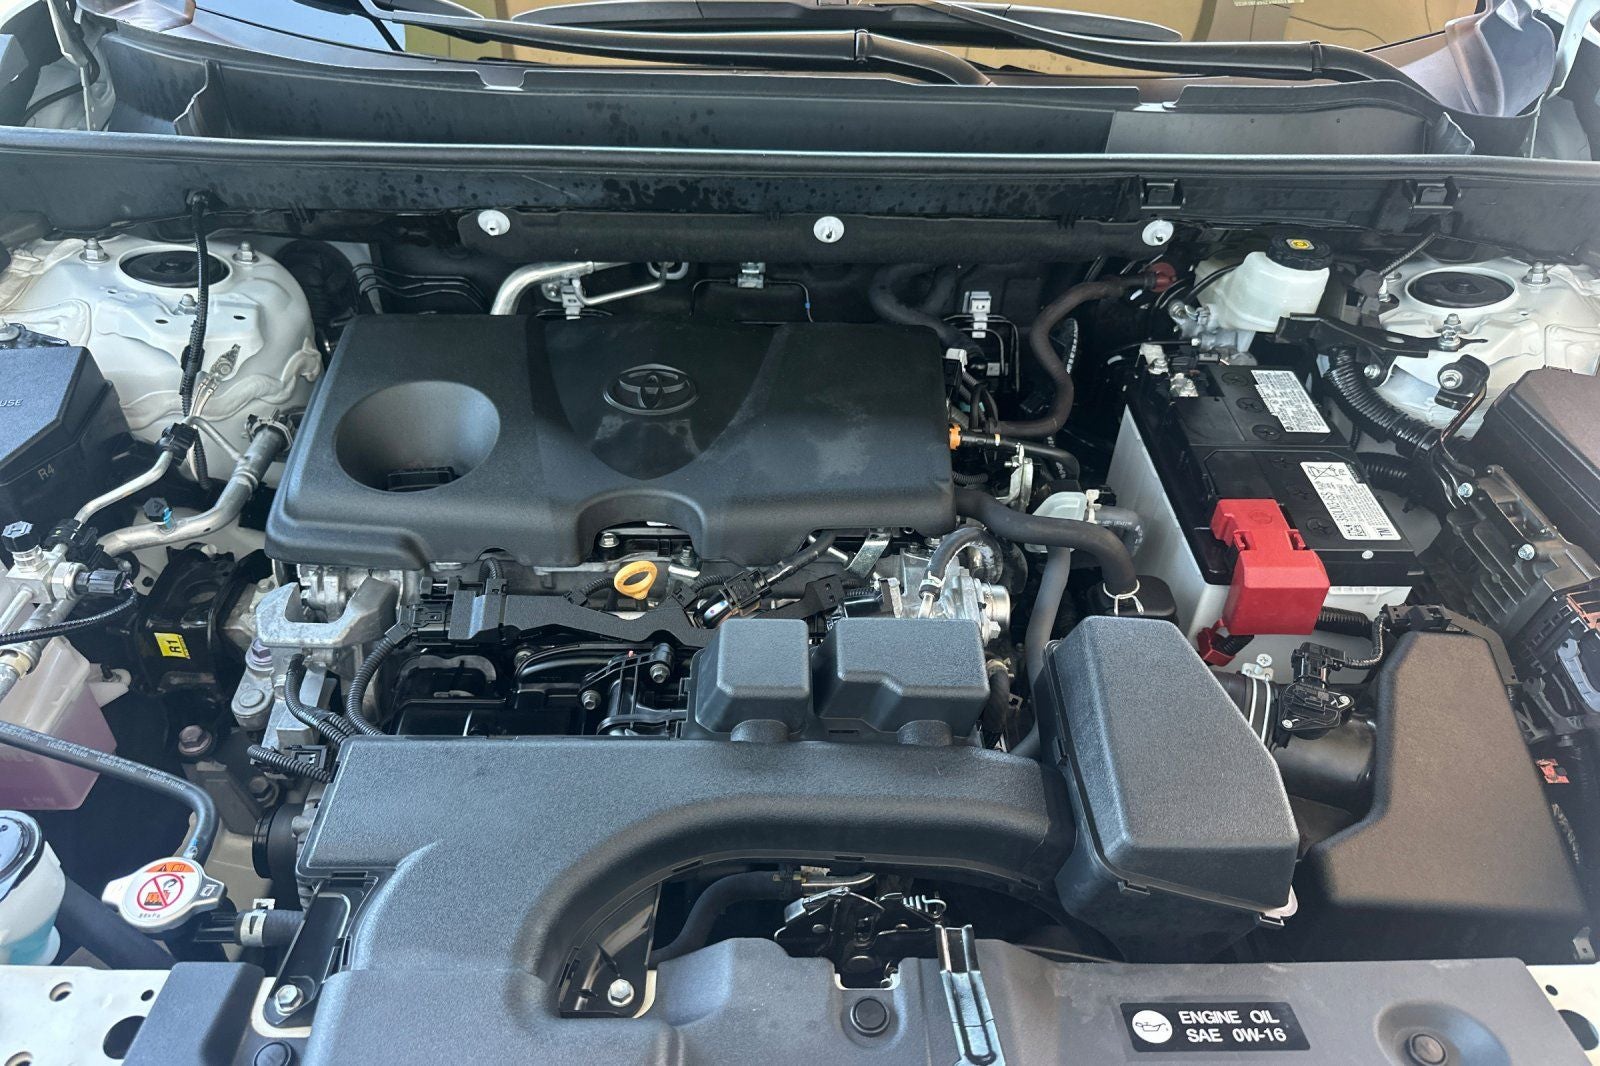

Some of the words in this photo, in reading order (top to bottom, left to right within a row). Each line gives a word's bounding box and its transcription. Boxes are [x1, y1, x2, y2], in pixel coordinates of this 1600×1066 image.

[38, 463, 55, 480] R4
[167, 640, 182, 653] R1
[1178, 1010, 1242, 1025] ENGINE
[1249, 1009, 1280, 1024] OIL
[1186, 1028, 1224, 1043] SAE
[1232, 1027, 1287, 1043] 0W-16
